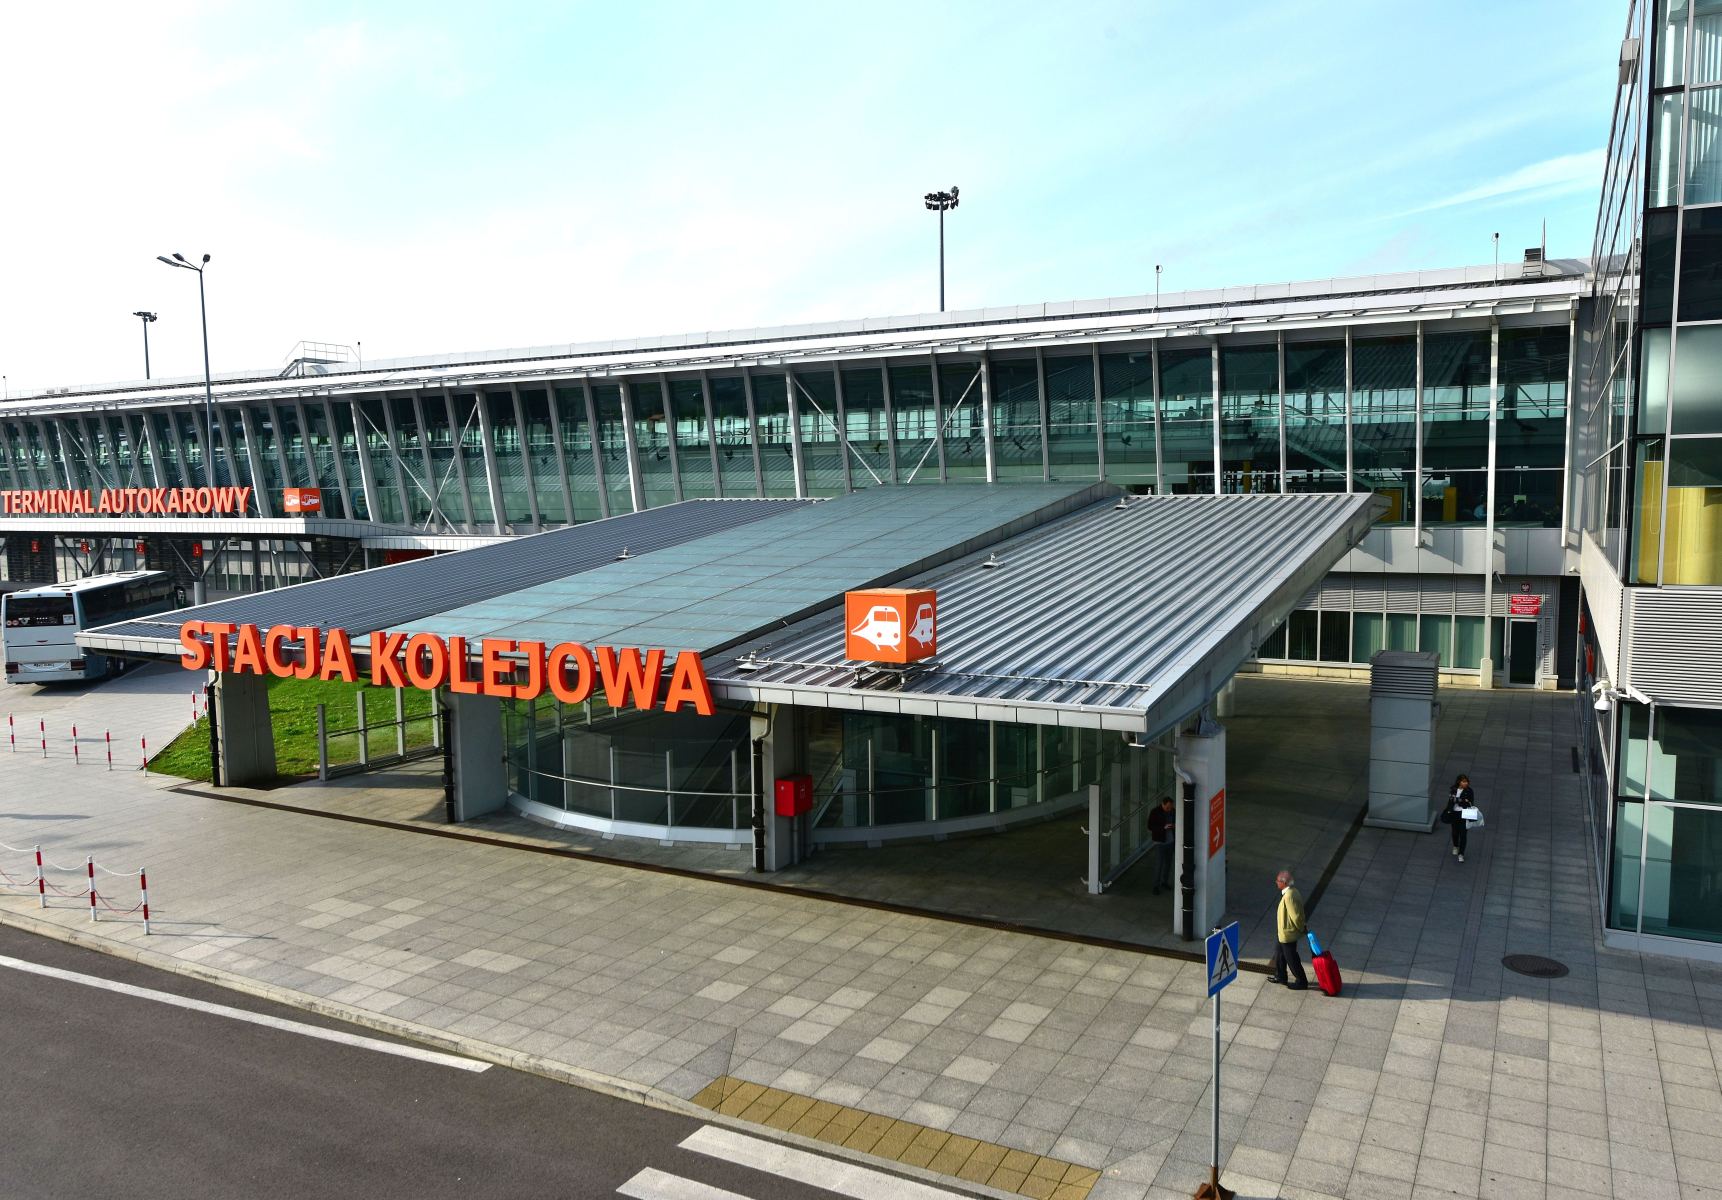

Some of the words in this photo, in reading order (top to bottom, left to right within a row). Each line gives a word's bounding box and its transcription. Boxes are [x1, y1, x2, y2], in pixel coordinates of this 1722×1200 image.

[1, 490, 95, 514] TERMINAL
[98, 487, 250, 514] AUTOKAROWY
[179, 619, 358, 683] STACJA
[370, 630, 717, 716] KOLEJOWA
